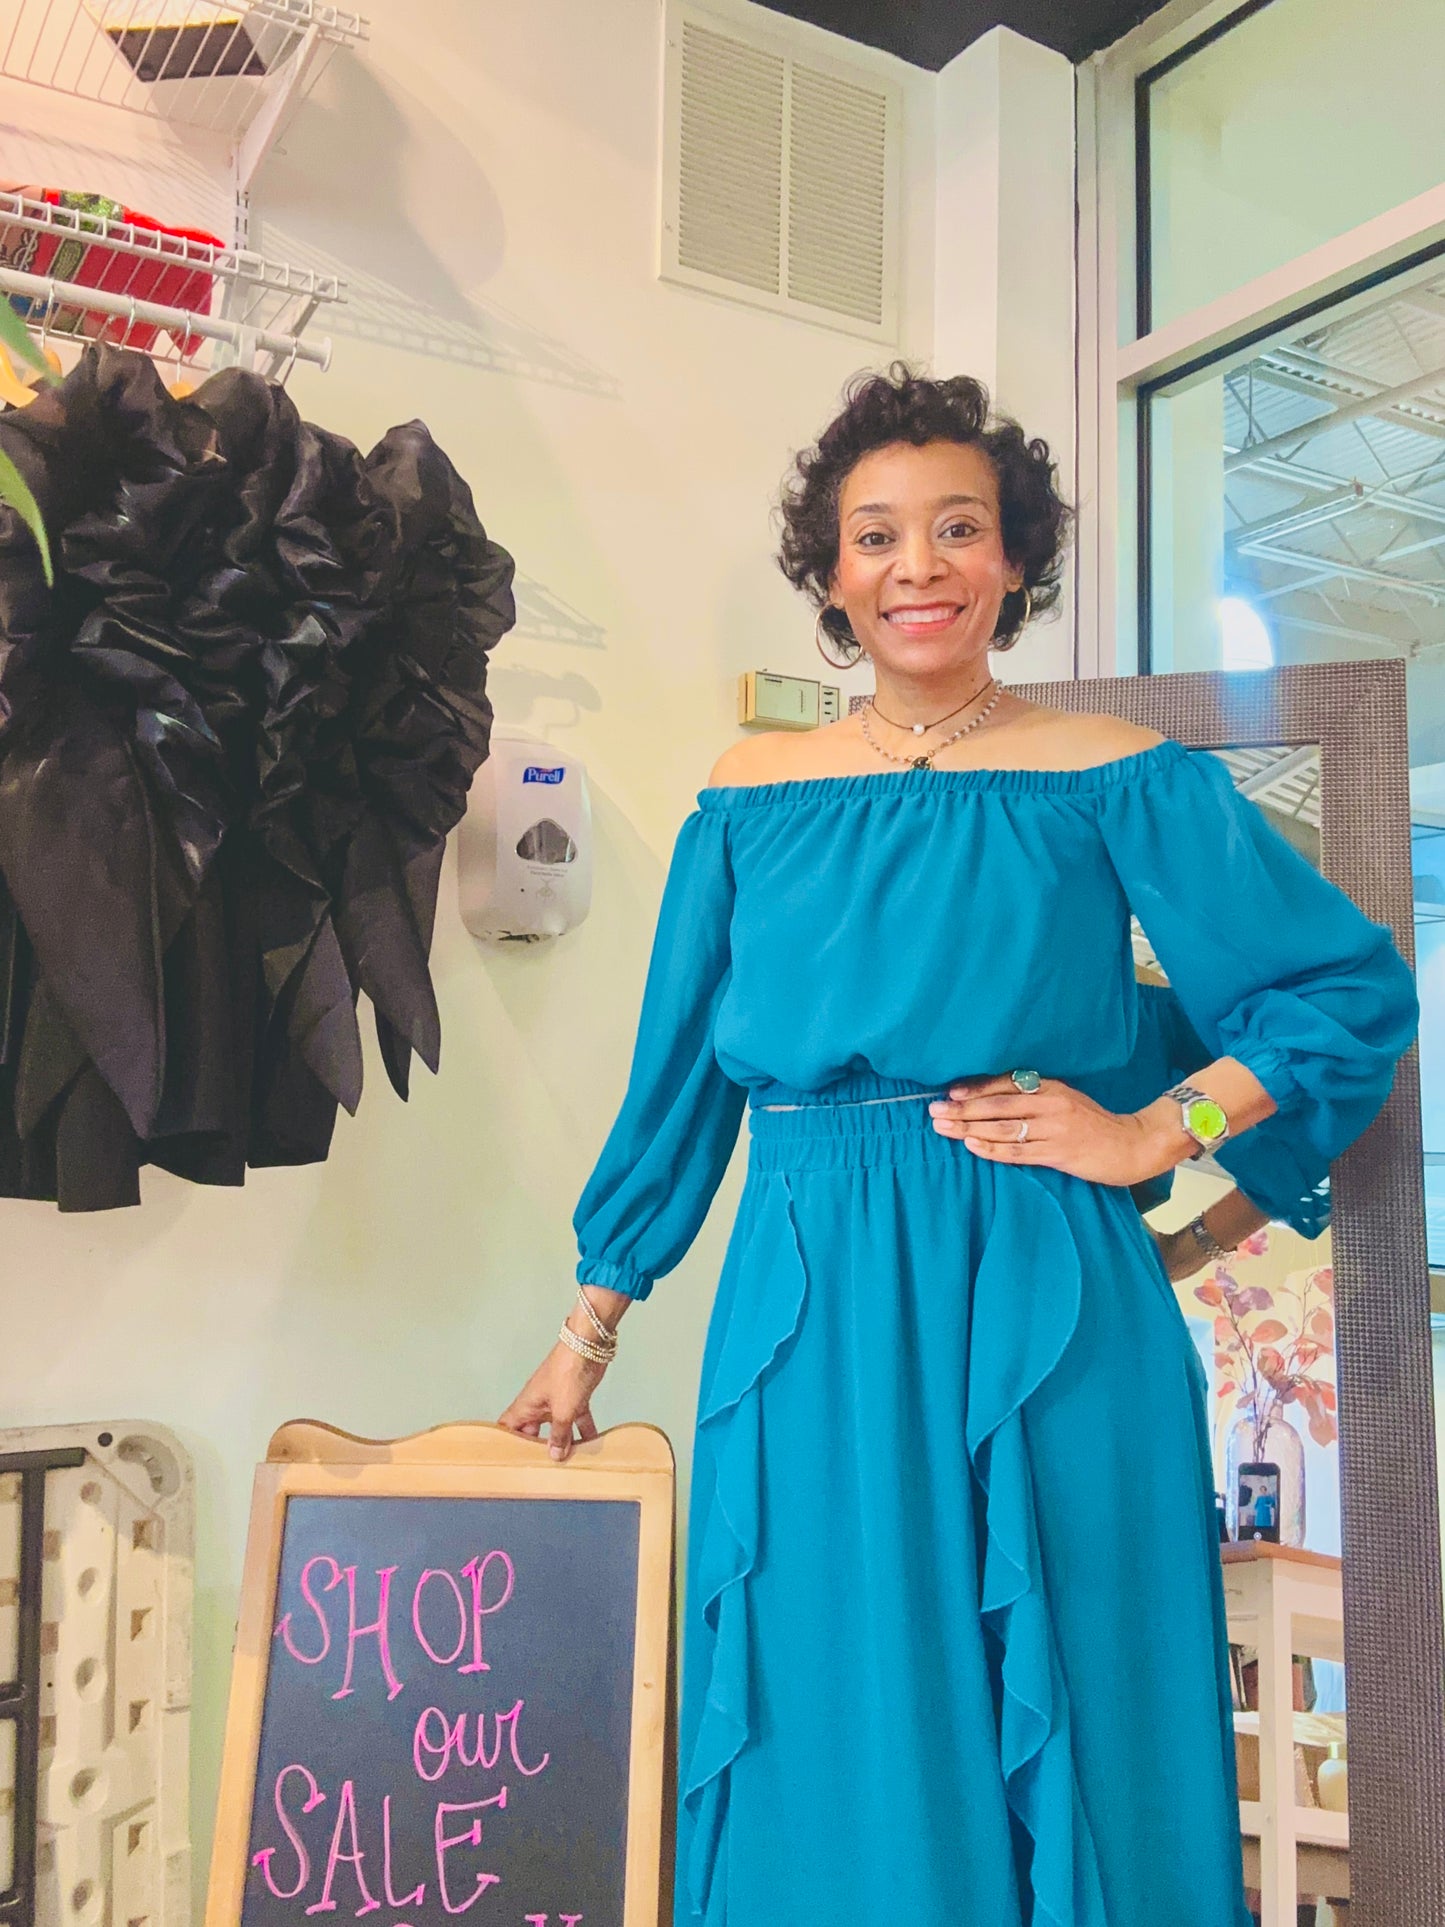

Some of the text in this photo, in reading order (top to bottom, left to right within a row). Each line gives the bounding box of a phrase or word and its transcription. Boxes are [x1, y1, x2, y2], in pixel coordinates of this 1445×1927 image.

[527, 768, 561, 782] Purell
[275, 1551, 515, 1700] SHOP
[413, 1700, 549, 1781] our
[253, 1764, 507, 1916] SALE
